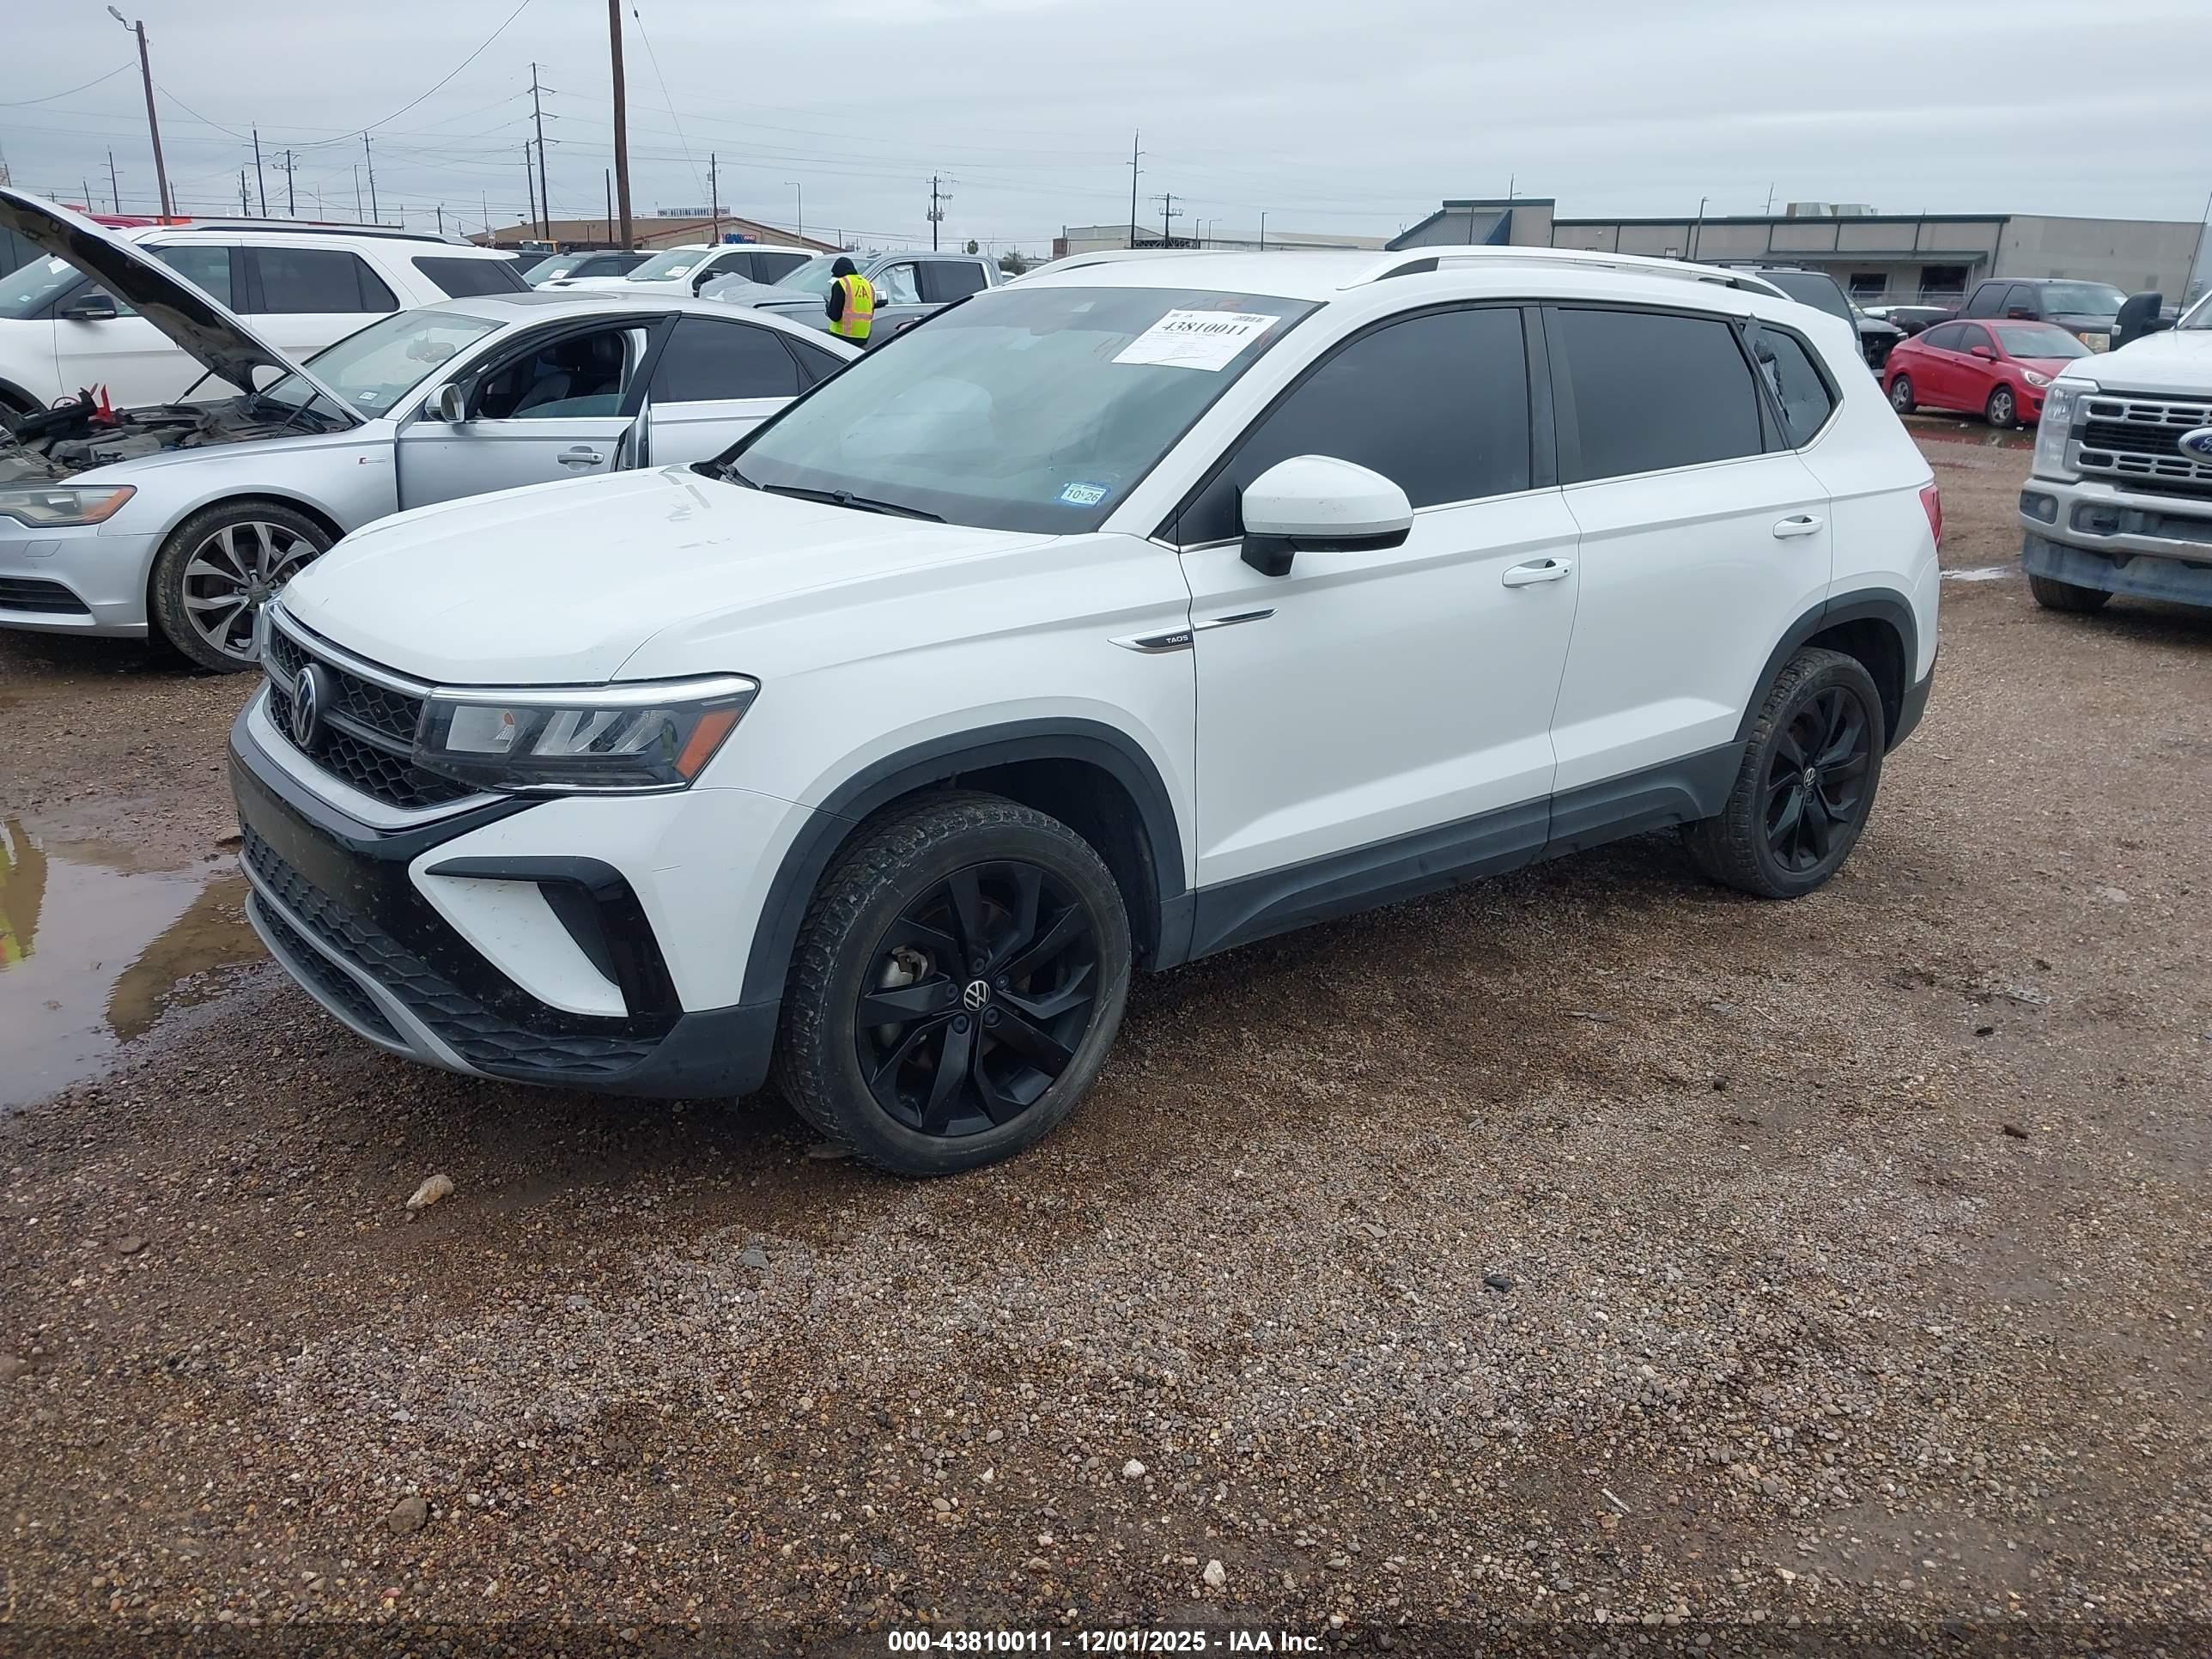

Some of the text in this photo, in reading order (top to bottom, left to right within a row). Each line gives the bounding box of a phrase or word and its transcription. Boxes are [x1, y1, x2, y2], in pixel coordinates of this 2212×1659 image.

[1162, 320, 1250, 336] 43810011
[1084, 492, 1101, 501] 26
[1165, 635, 1189, 644] TAOS
